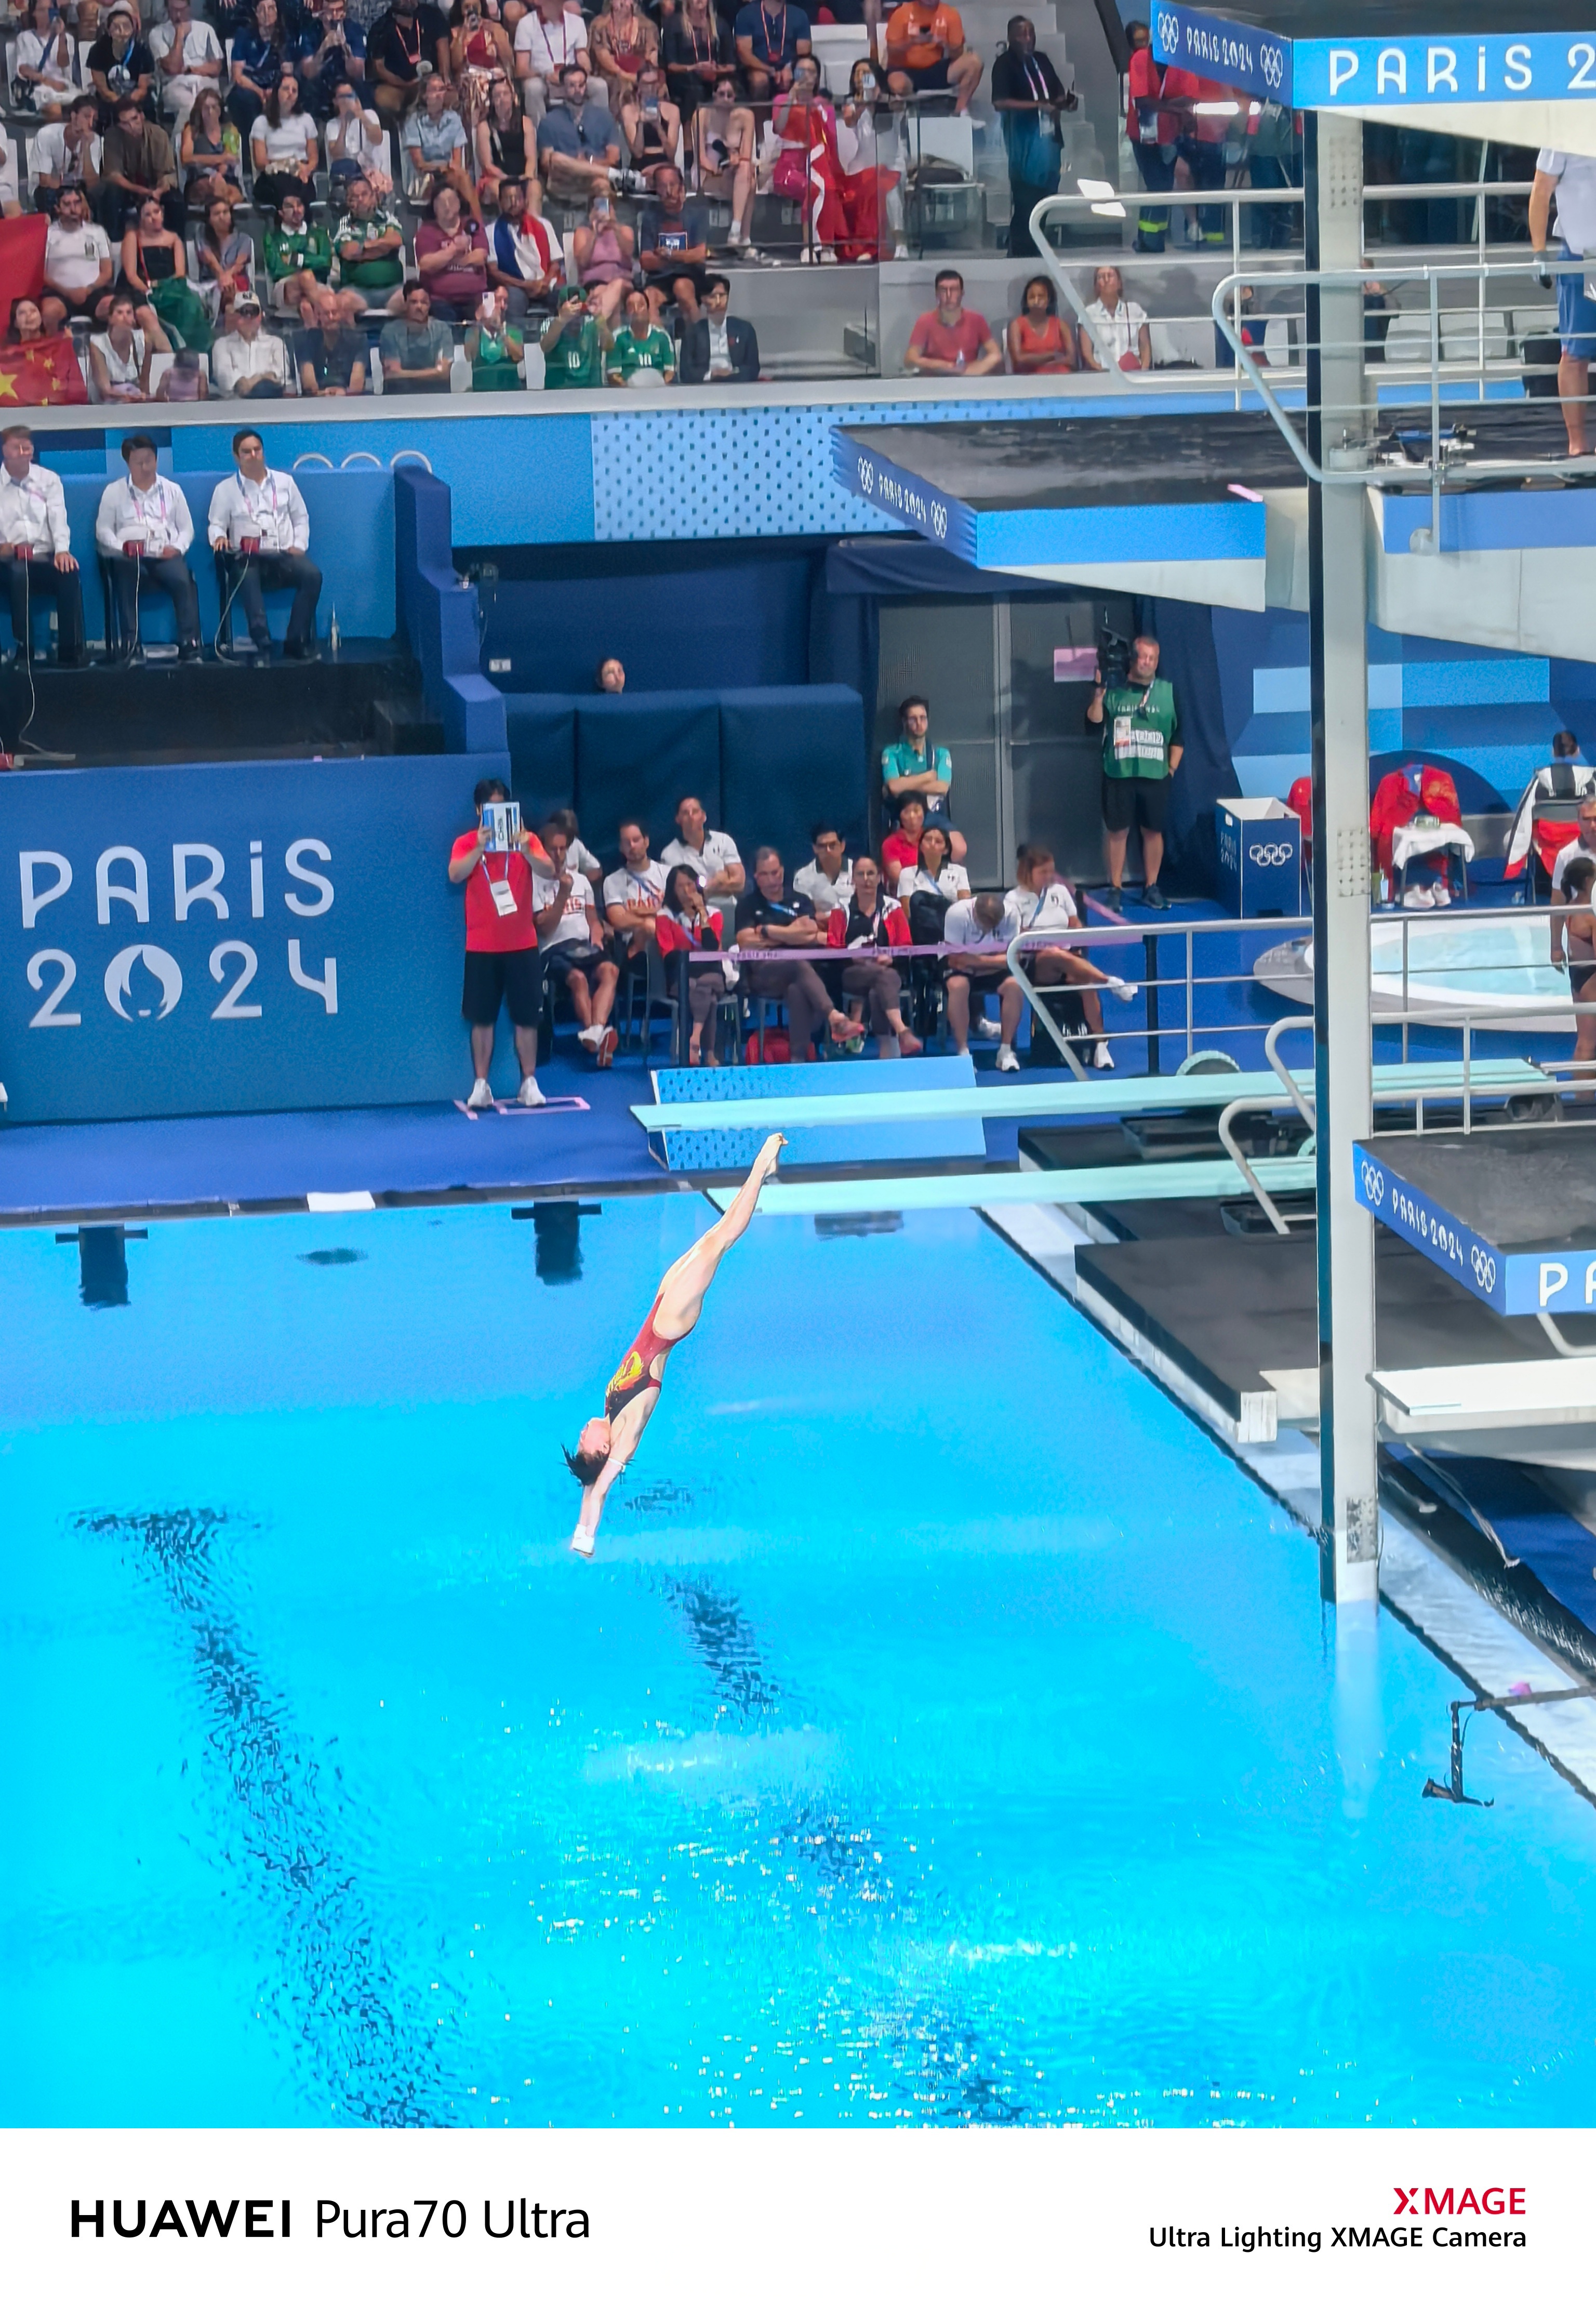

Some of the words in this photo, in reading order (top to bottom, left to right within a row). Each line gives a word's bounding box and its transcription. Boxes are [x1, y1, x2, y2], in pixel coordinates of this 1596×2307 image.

[1222, 37, 1253, 74] 2024
[904, 488, 926, 525] 2024
[27, 939, 338, 1027] 2024
[1430, 1217, 1464, 1267] 2024
